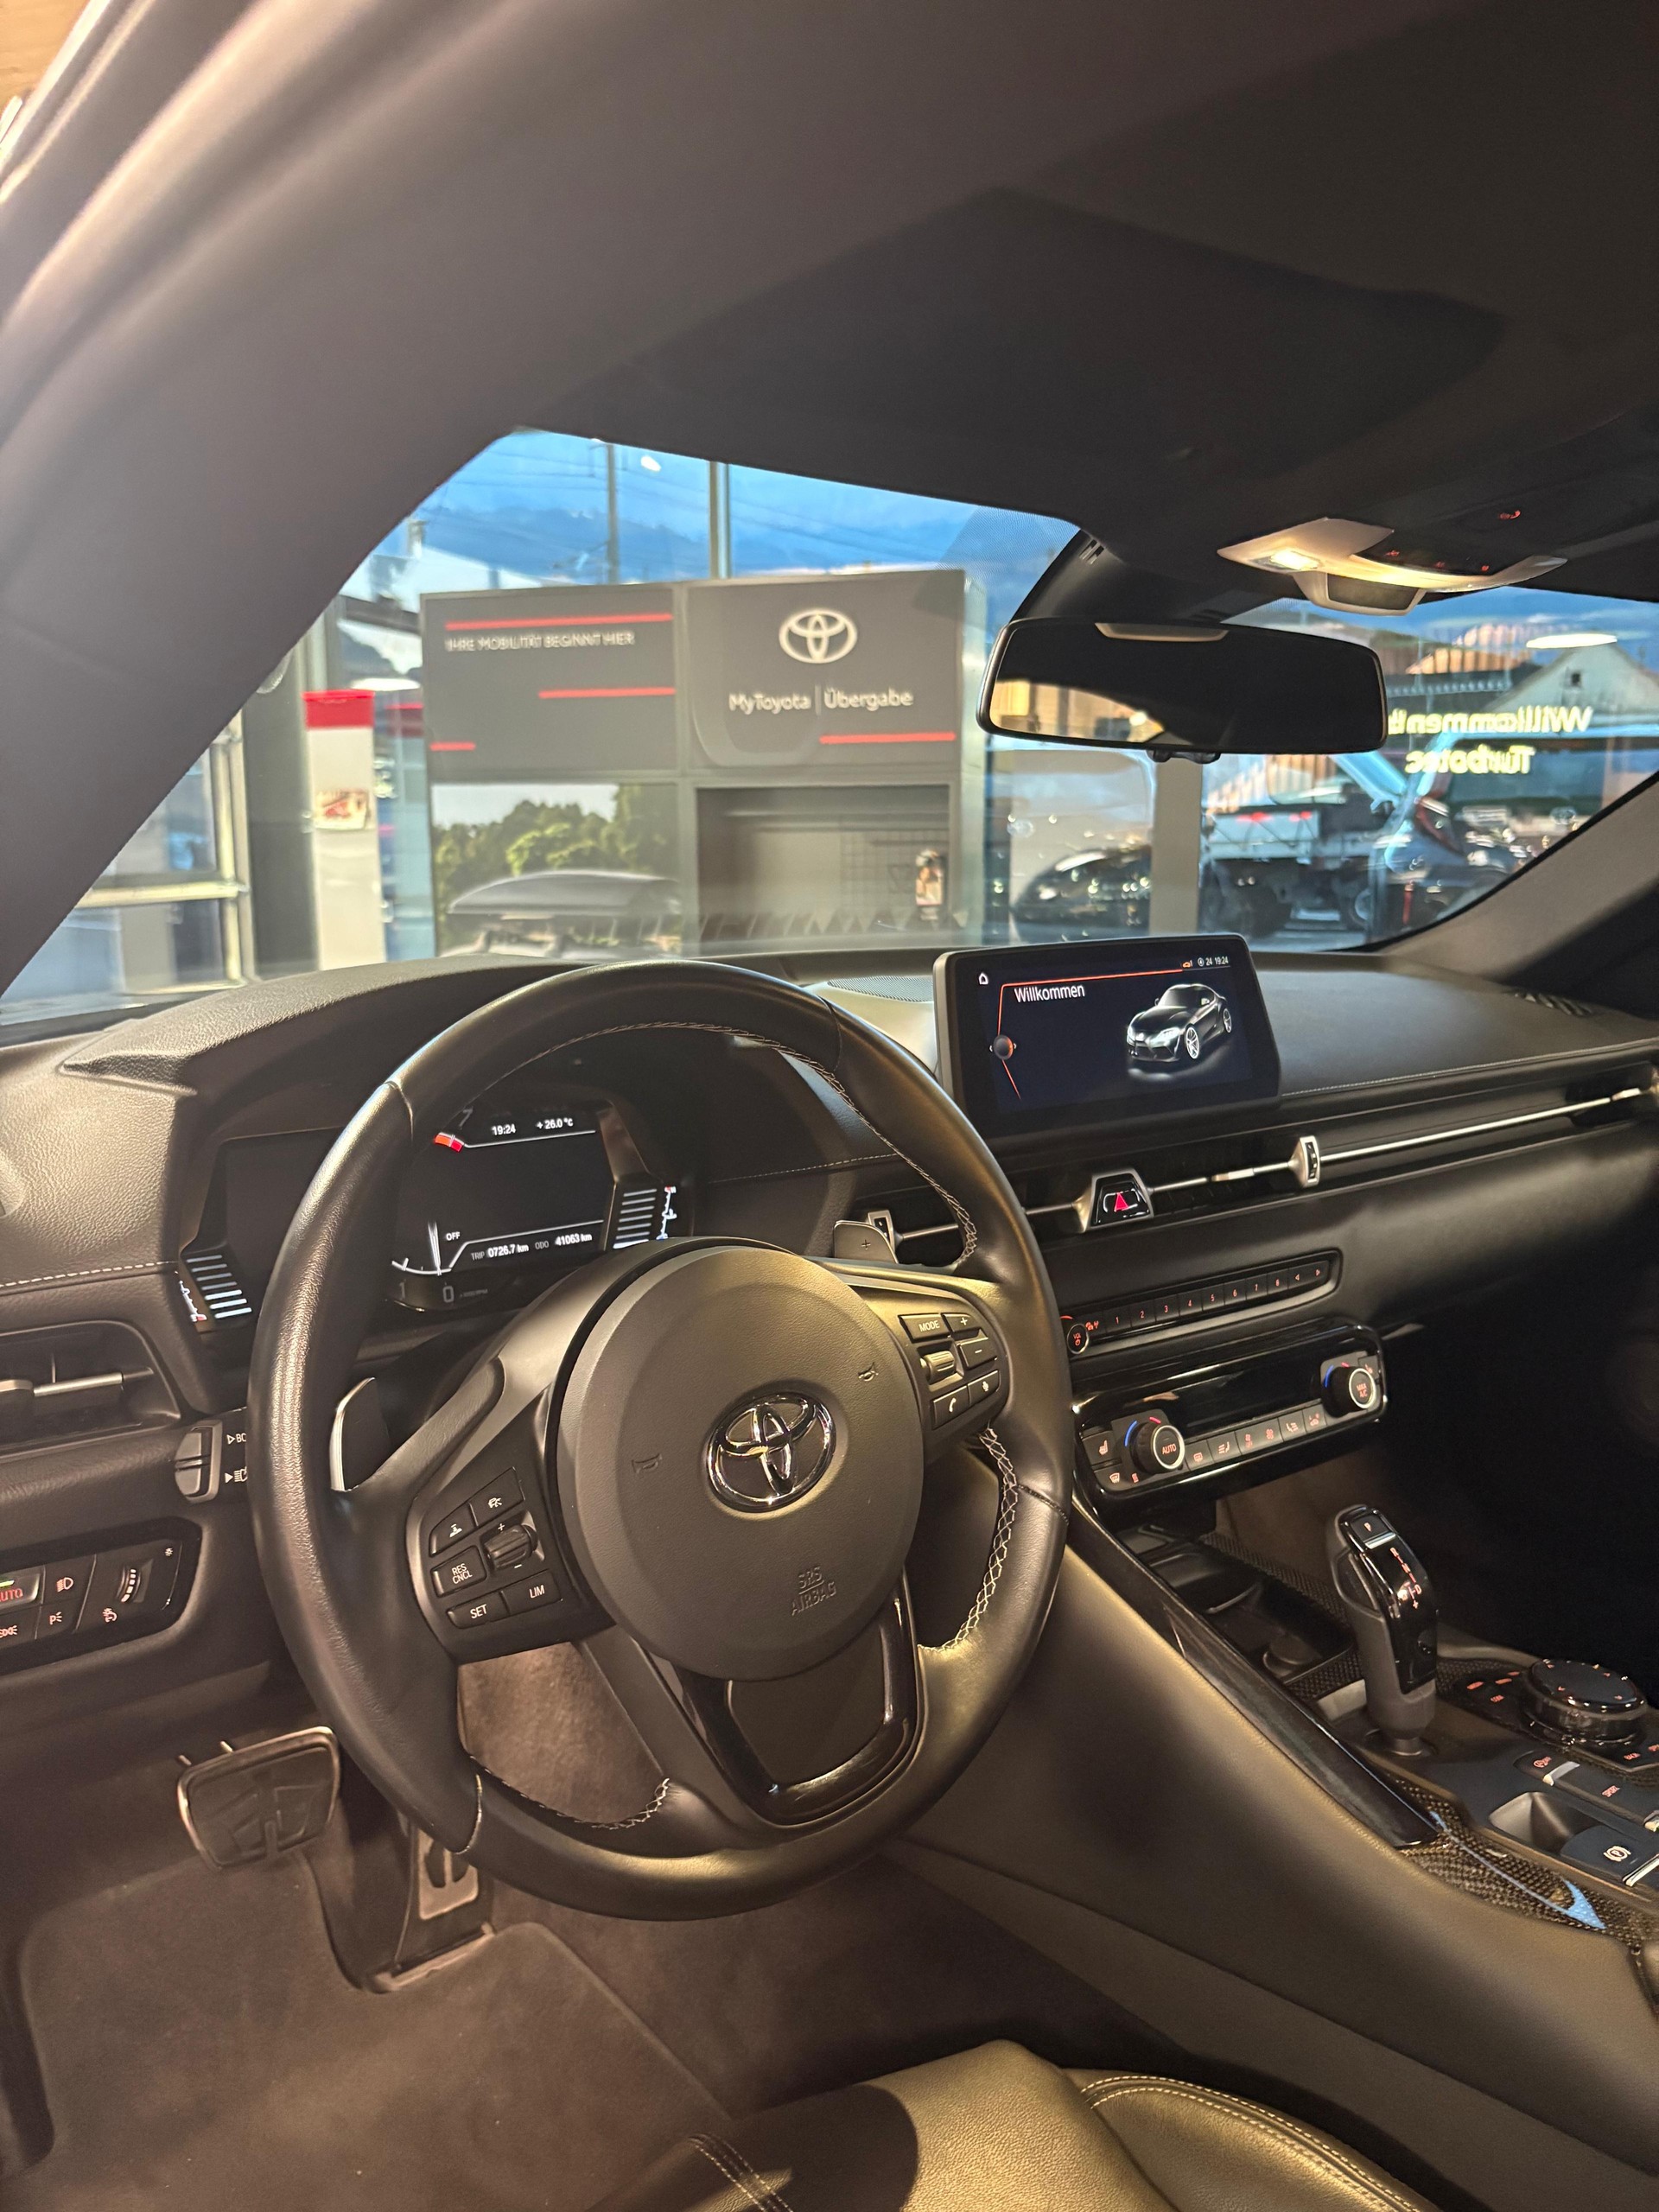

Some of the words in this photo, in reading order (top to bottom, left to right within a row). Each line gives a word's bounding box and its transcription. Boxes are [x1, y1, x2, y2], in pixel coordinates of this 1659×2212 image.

[728, 692, 812, 715] MyToyota
[823, 686, 914, 712] Übergabe
[1014, 983, 1085, 1003] Willkommen
[492, 1123, 516, 1135] 19:24
[545, 1118, 563, 1130] 26.0
[446, 1231, 461, 1242] OFF
[471, 1251, 486, 1262] TRIP
[486, 1243, 516, 1258] 0726.7
[517, 1243, 530, 1254] km
[535, 1241, 550, 1250] ODO
[555, 1234, 580, 1247] 41063
[581, 1233, 593, 1243] km
[918, 1320, 940, 1332] MODE
[1161, 1443, 1177, 1455] AUTO
[451, 1563, 467, 1575] RES
[452, 1571, 473, 1585] CNCL
[0, 1587, 23, 1602] UTO
[529, 1585, 545, 1599] LIM
[470, 1604, 487, 1619] SET
